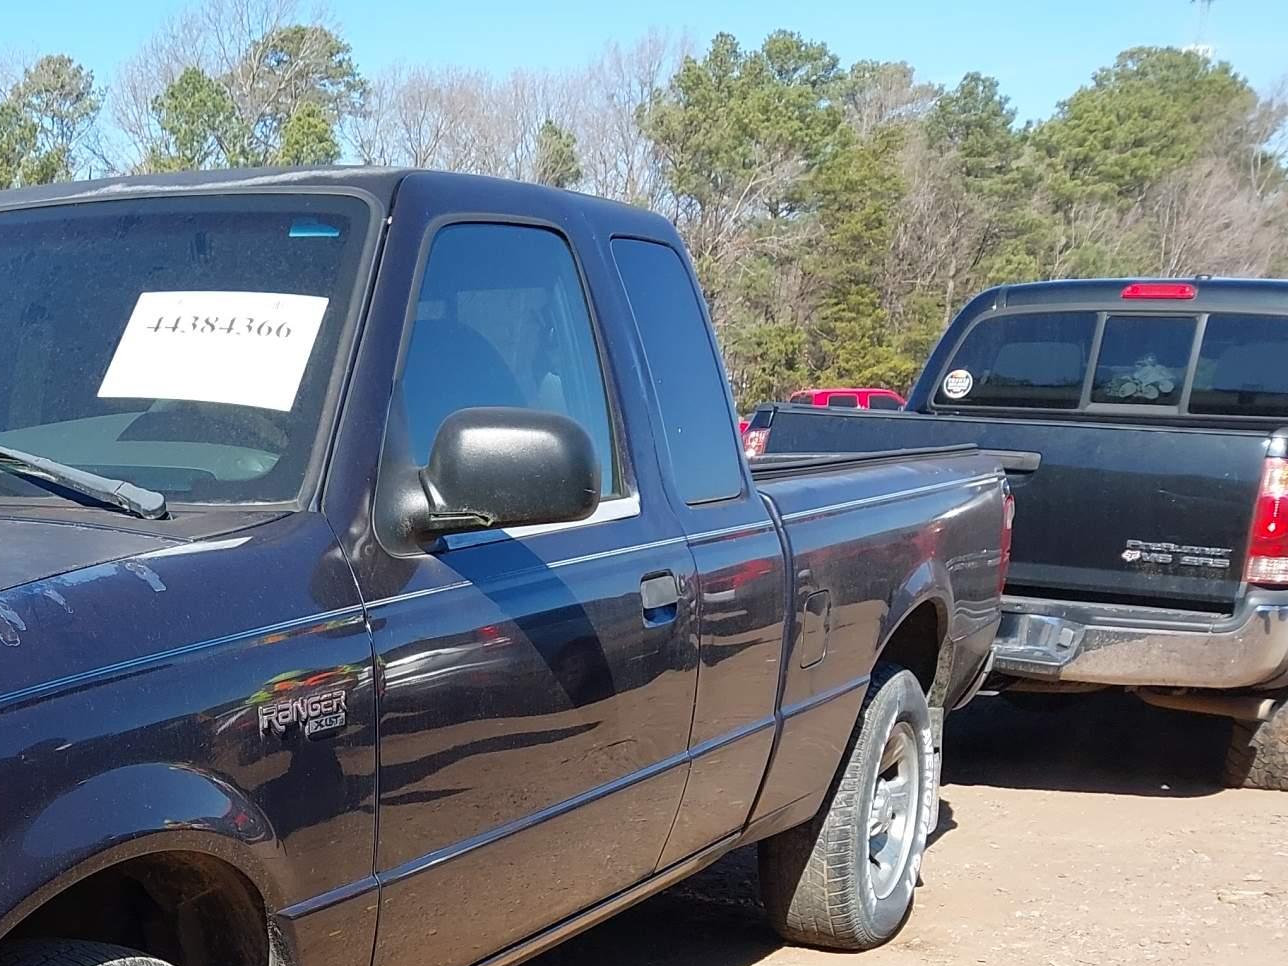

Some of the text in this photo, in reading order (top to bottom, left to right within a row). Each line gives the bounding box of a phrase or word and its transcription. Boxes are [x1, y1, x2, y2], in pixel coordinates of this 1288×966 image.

[146, 315, 293, 339] 44384366
[258, 690, 348, 736] RANGER
[311, 714, 344, 732] XLT
